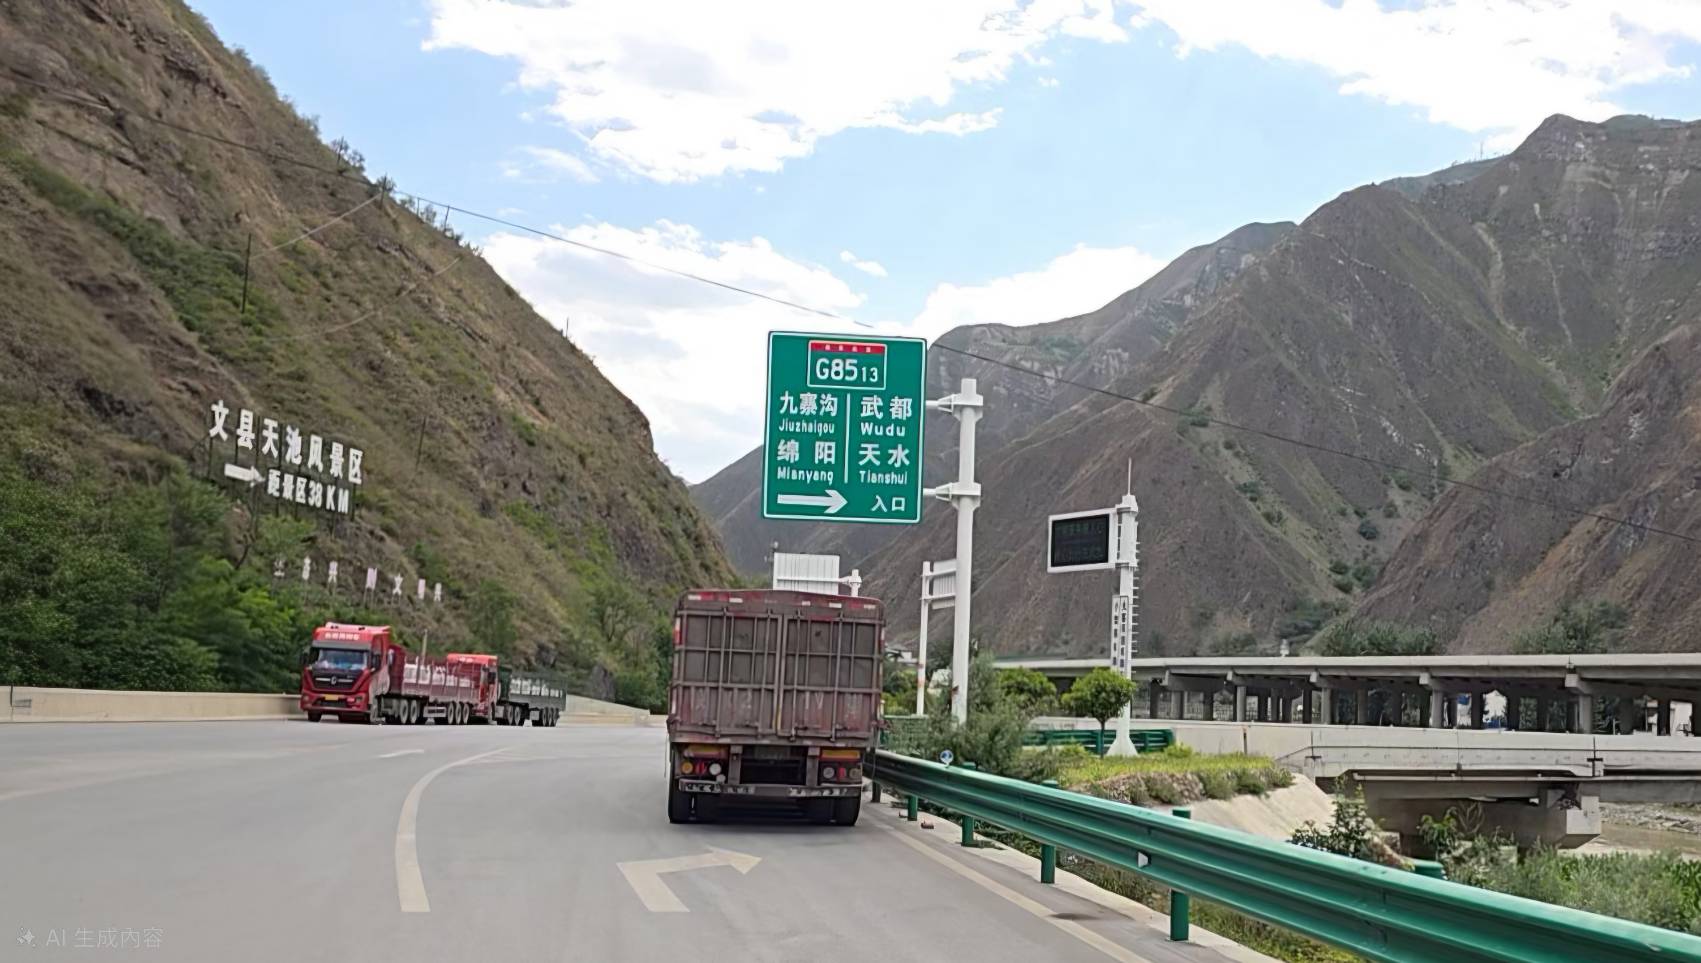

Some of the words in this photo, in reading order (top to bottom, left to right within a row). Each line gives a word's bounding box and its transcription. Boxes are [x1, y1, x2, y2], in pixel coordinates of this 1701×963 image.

[779, 390, 838, 417] 九寨沟
[860, 395, 913, 421] 武都
[778, 418, 835, 437] Jiuzhaigou
[860, 422, 906, 437] Wudu
[209, 400, 363, 485] 文县天池风景区
[776, 439, 836, 465] 绵阳
[858, 443, 911, 468] 天水
[776, 466, 834, 485] Mianyang
[859, 470, 908, 485] Tianshui
[870, 495, 906, 513] 入口
